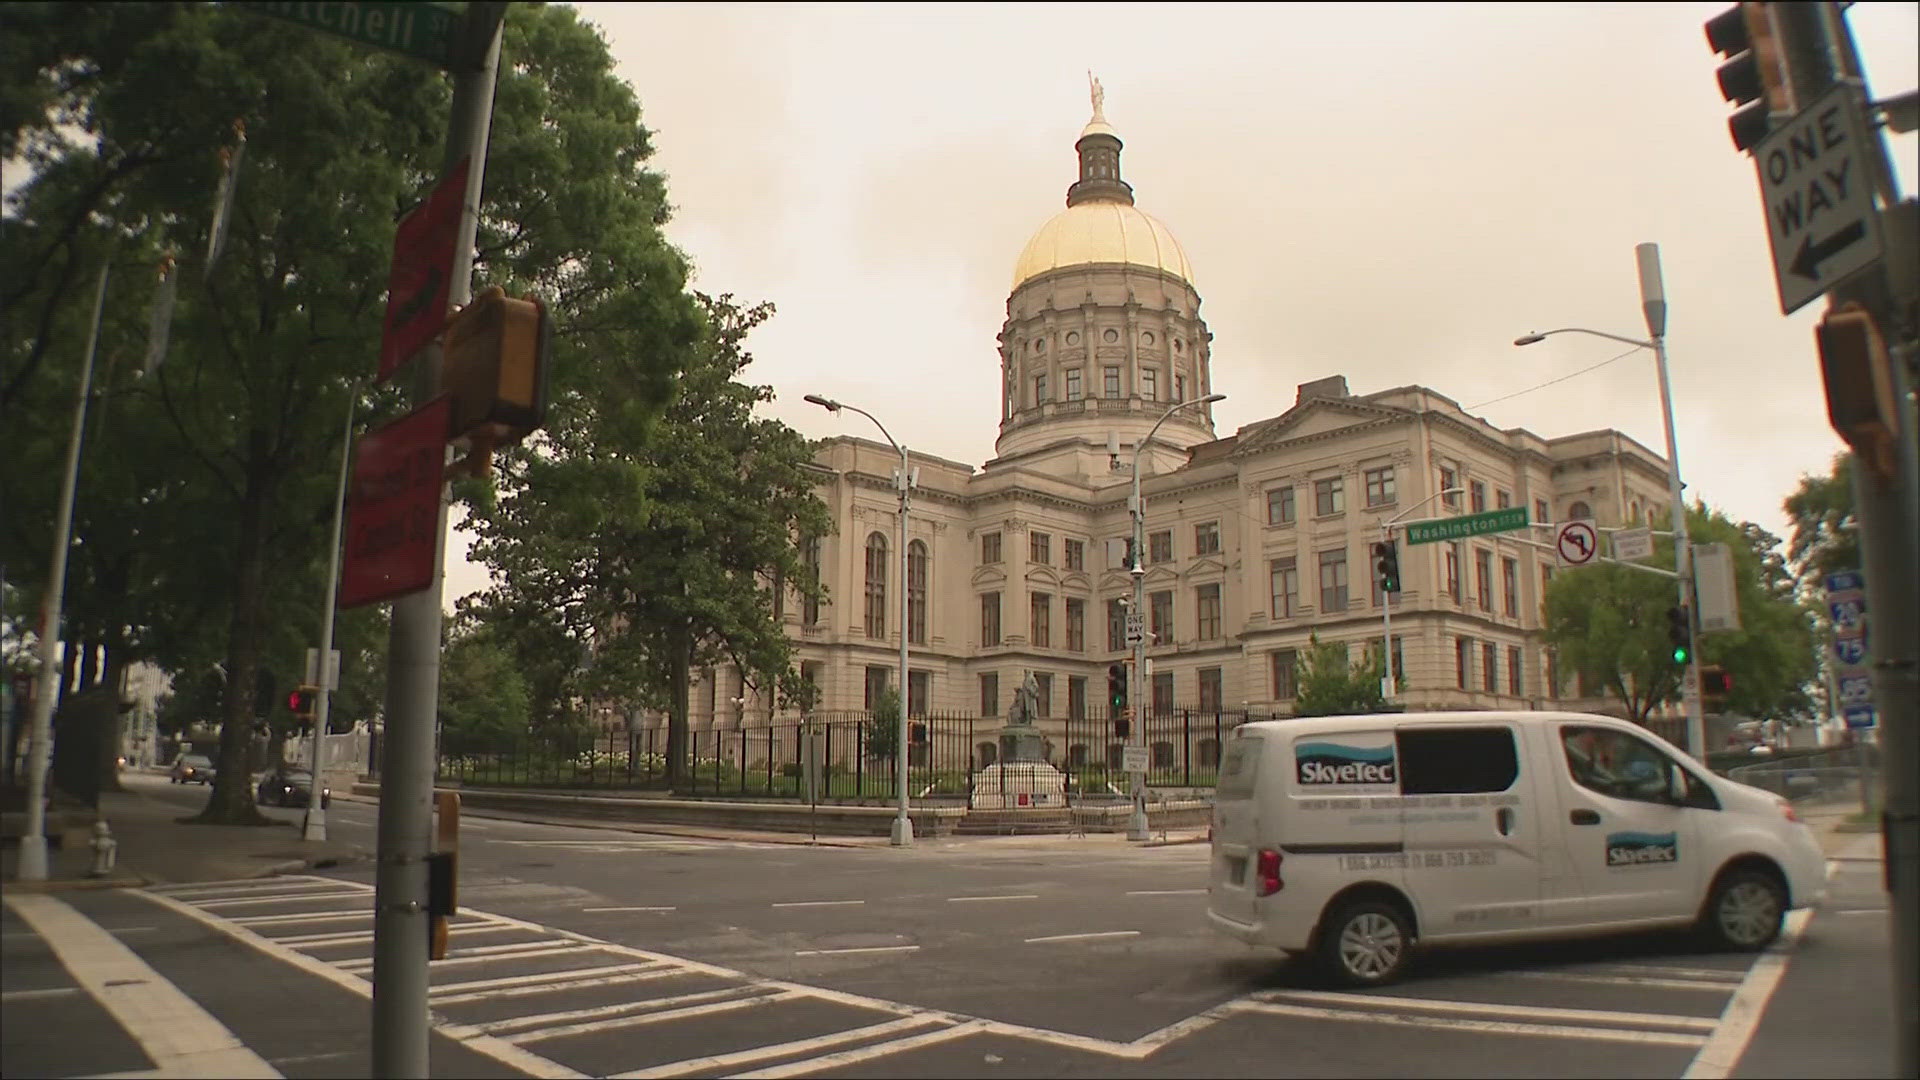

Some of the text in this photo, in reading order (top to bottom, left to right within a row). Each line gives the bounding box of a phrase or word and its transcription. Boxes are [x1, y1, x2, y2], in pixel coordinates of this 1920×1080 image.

[1767, 107, 1845, 186] ONE
[1775, 156, 1851, 239] WAY
[1410, 519, 1498, 540] Washington
[1127, 616, 1144, 625] ONE
[1127, 625, 1144, 634] WAY
[1300, 760, 1393, 784] SkyeTec
[1609, 844, 1676, 863] SkyeTec
